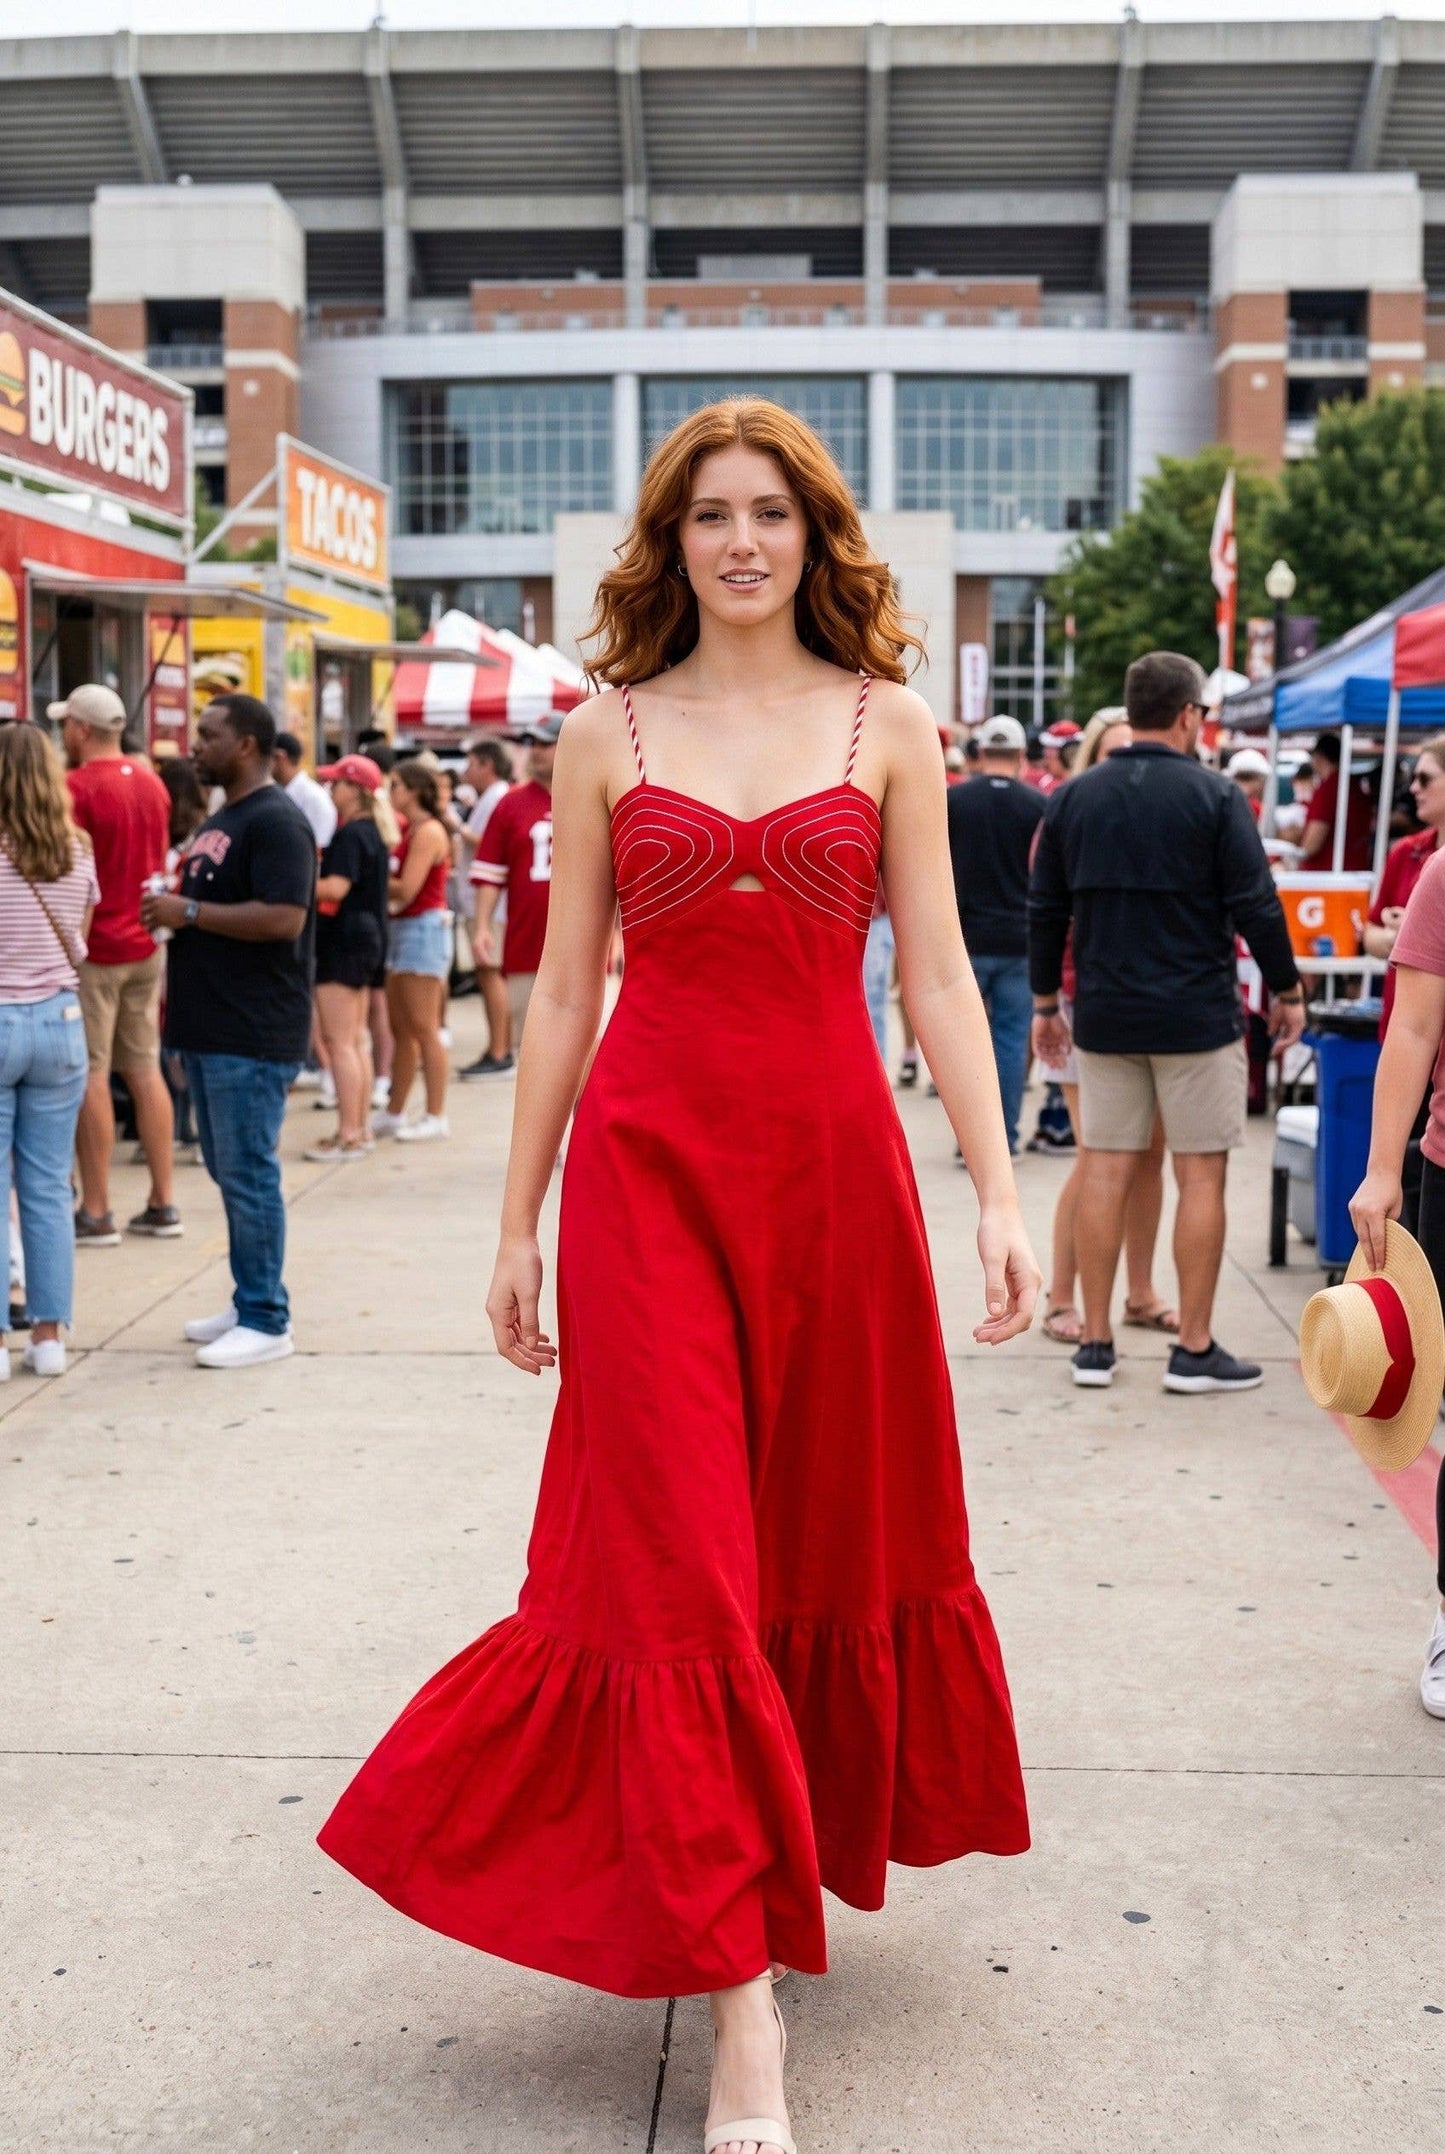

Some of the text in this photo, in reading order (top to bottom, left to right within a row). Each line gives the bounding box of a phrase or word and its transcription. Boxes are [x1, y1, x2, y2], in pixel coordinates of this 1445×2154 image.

[29, 348, 170, 492] BURGERS
[297, 467, 377, 569] TACOS
[1297, 896, 1325, 928] G
